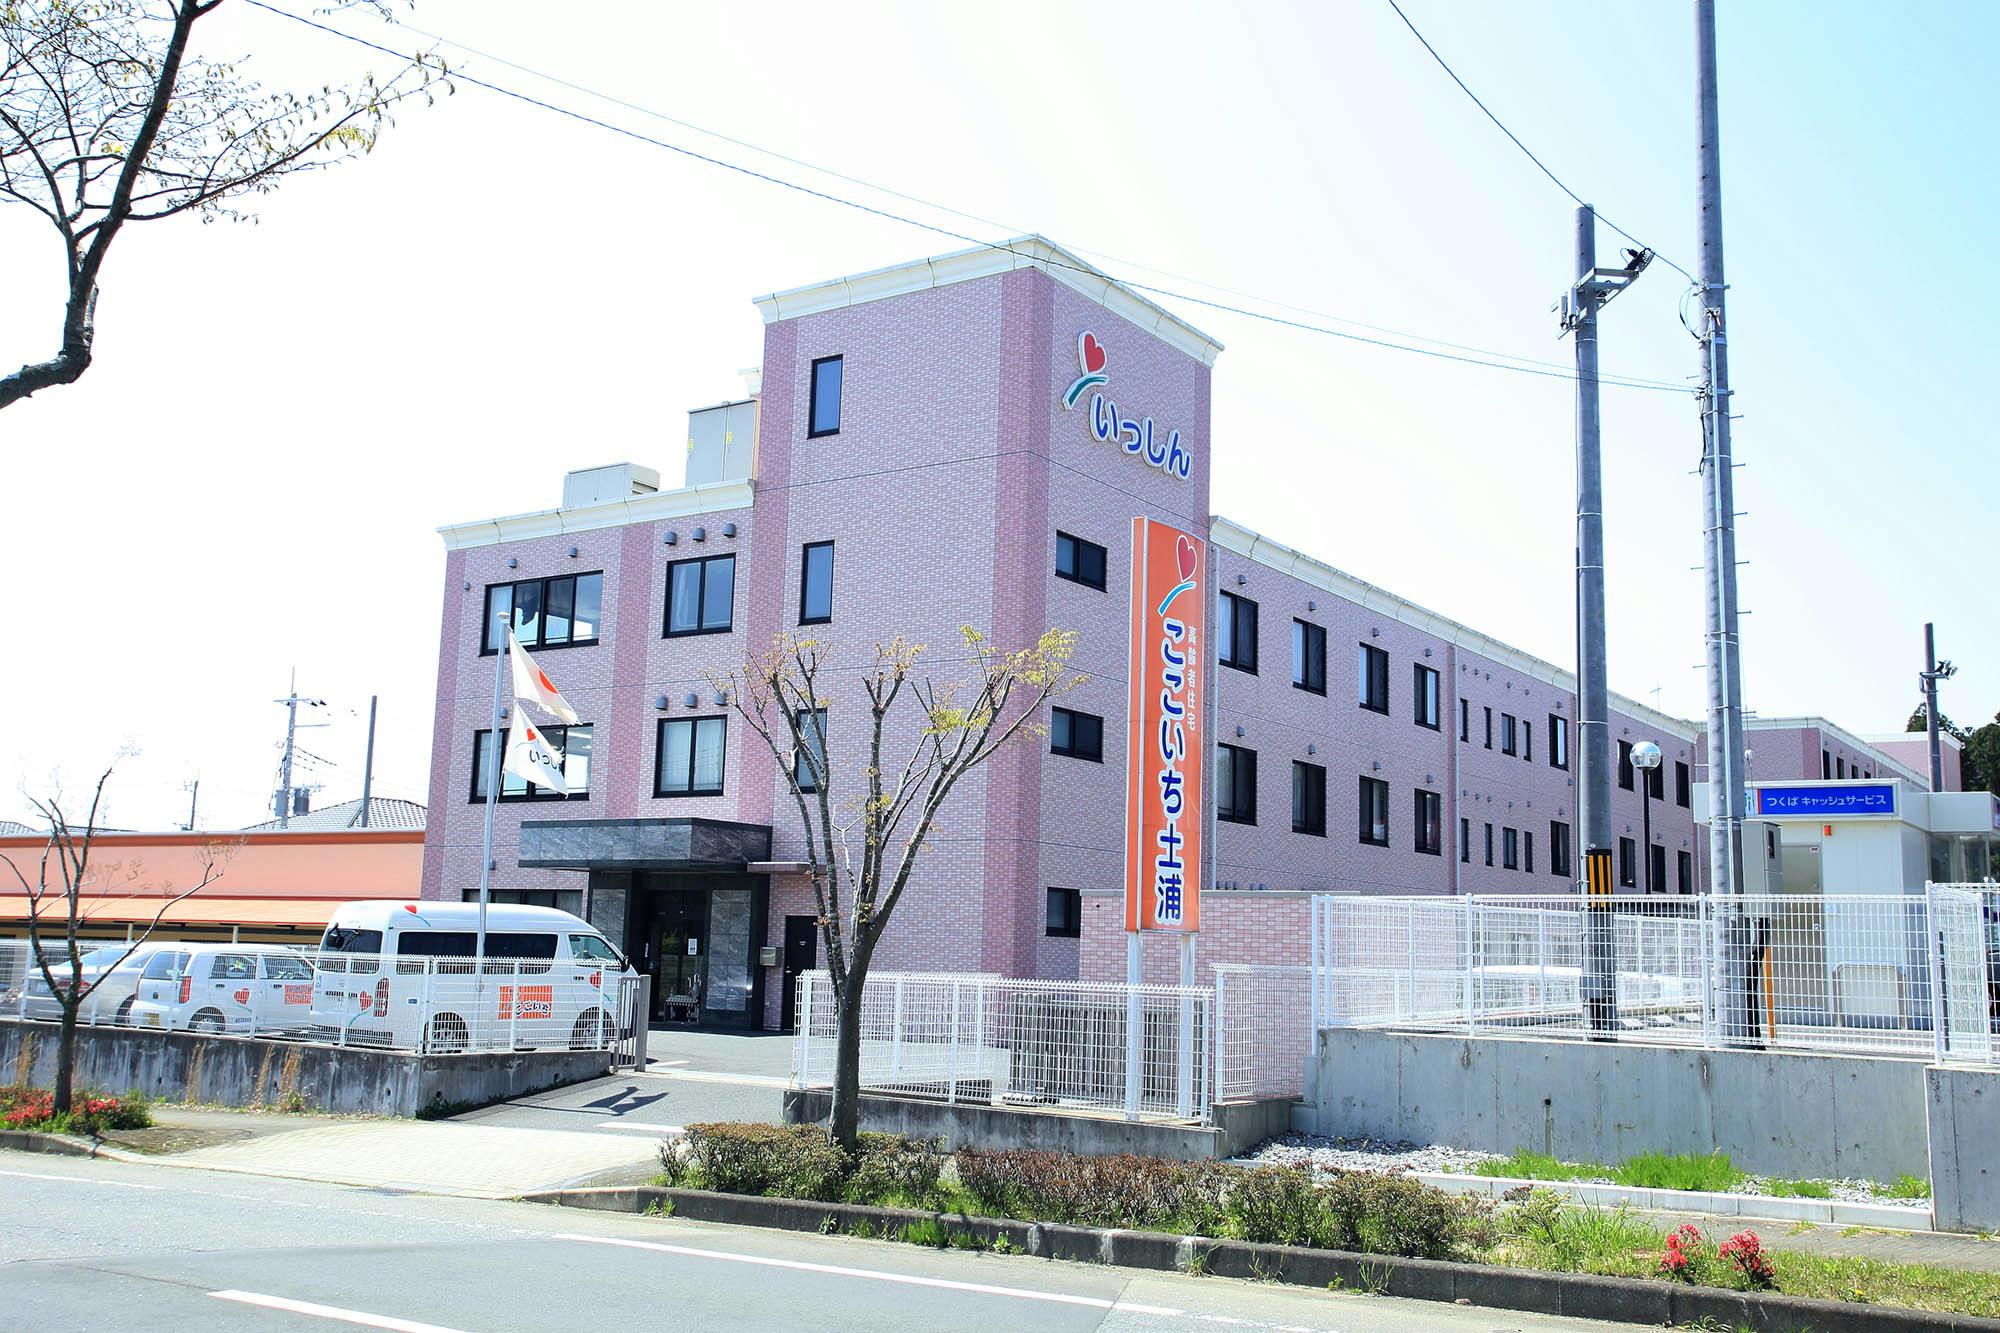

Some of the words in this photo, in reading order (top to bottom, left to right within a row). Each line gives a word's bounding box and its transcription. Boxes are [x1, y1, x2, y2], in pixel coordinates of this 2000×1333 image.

[1091, 394, 1191, 479] いっしん
[1156, 619, 1184, 922] ここいち土浦
